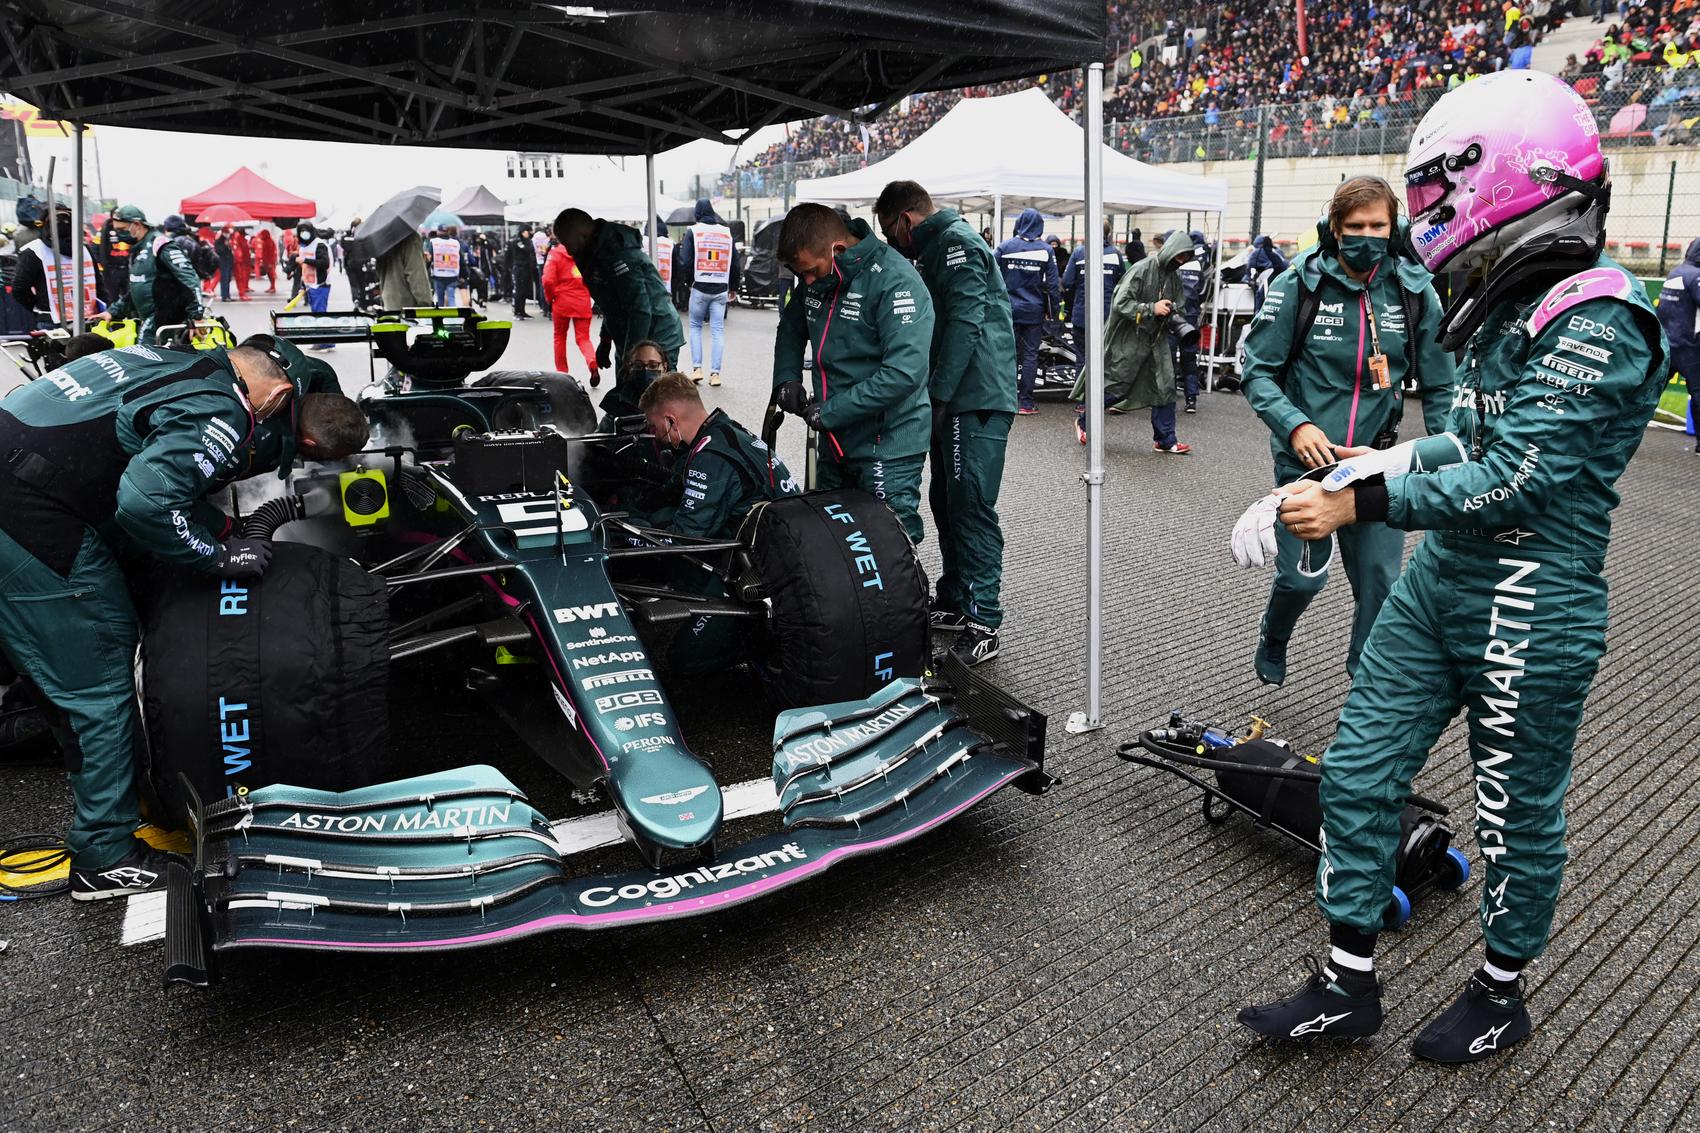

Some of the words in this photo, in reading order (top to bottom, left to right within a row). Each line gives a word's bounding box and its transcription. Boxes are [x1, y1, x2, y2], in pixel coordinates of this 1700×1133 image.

[1423, 222, 1447, 243] BWT
[894, 290, 912, 299] EPOS
[1315, 317, 1343, 326] JCB
[1567, 314, 1617, 341] EPOS
[1561, 340, 1605, 359] RAVENOL
[1535, 371, 1595, 396] REPLAY
[1544, 393, 1566, 406] GP
[202, 435, 227, 464] HACKETT
[952, 444, 961, 481] ASTON
[688, 469, 707, 481] EPOS
[1462, 487, 1515, 512] ASTON
[1509, 442, 1541, 493] MARTIN
[170, 509, 192, 539] ASTON
[496, 500, 589, 537] 5
[230, 552, 257, 564] HyFlex
[823, 503, 855, 525] LF
[845, 530, 884, 591] WET
[219, 578, 249, 616] RF
[552, 602, 619, 624] BWT
[691, 615, 712, 637] AST
[566, 635, 637, 650] SentinelOne
[1478, 557, 1541, 738] MARTIN
[572, 650, 646, 670] NetApp
[874, 651, 894, 681] LF
[581, 669, 655, 691] PIRELLI
[599, 691, 662, 712] JCB
[634, 712, 667, 729] IFS
[218, 696, 252, 776] WET
[622, 735, 676, 754] PERONI
[783, 732, 849, 768] ASTON
[842, 702, 913, 743] MARTIN
[279, 812, 383, 834] ASTON
[392, 804, 512, 832] MARTIN
[579, 842, 808, 908] Cognizant
